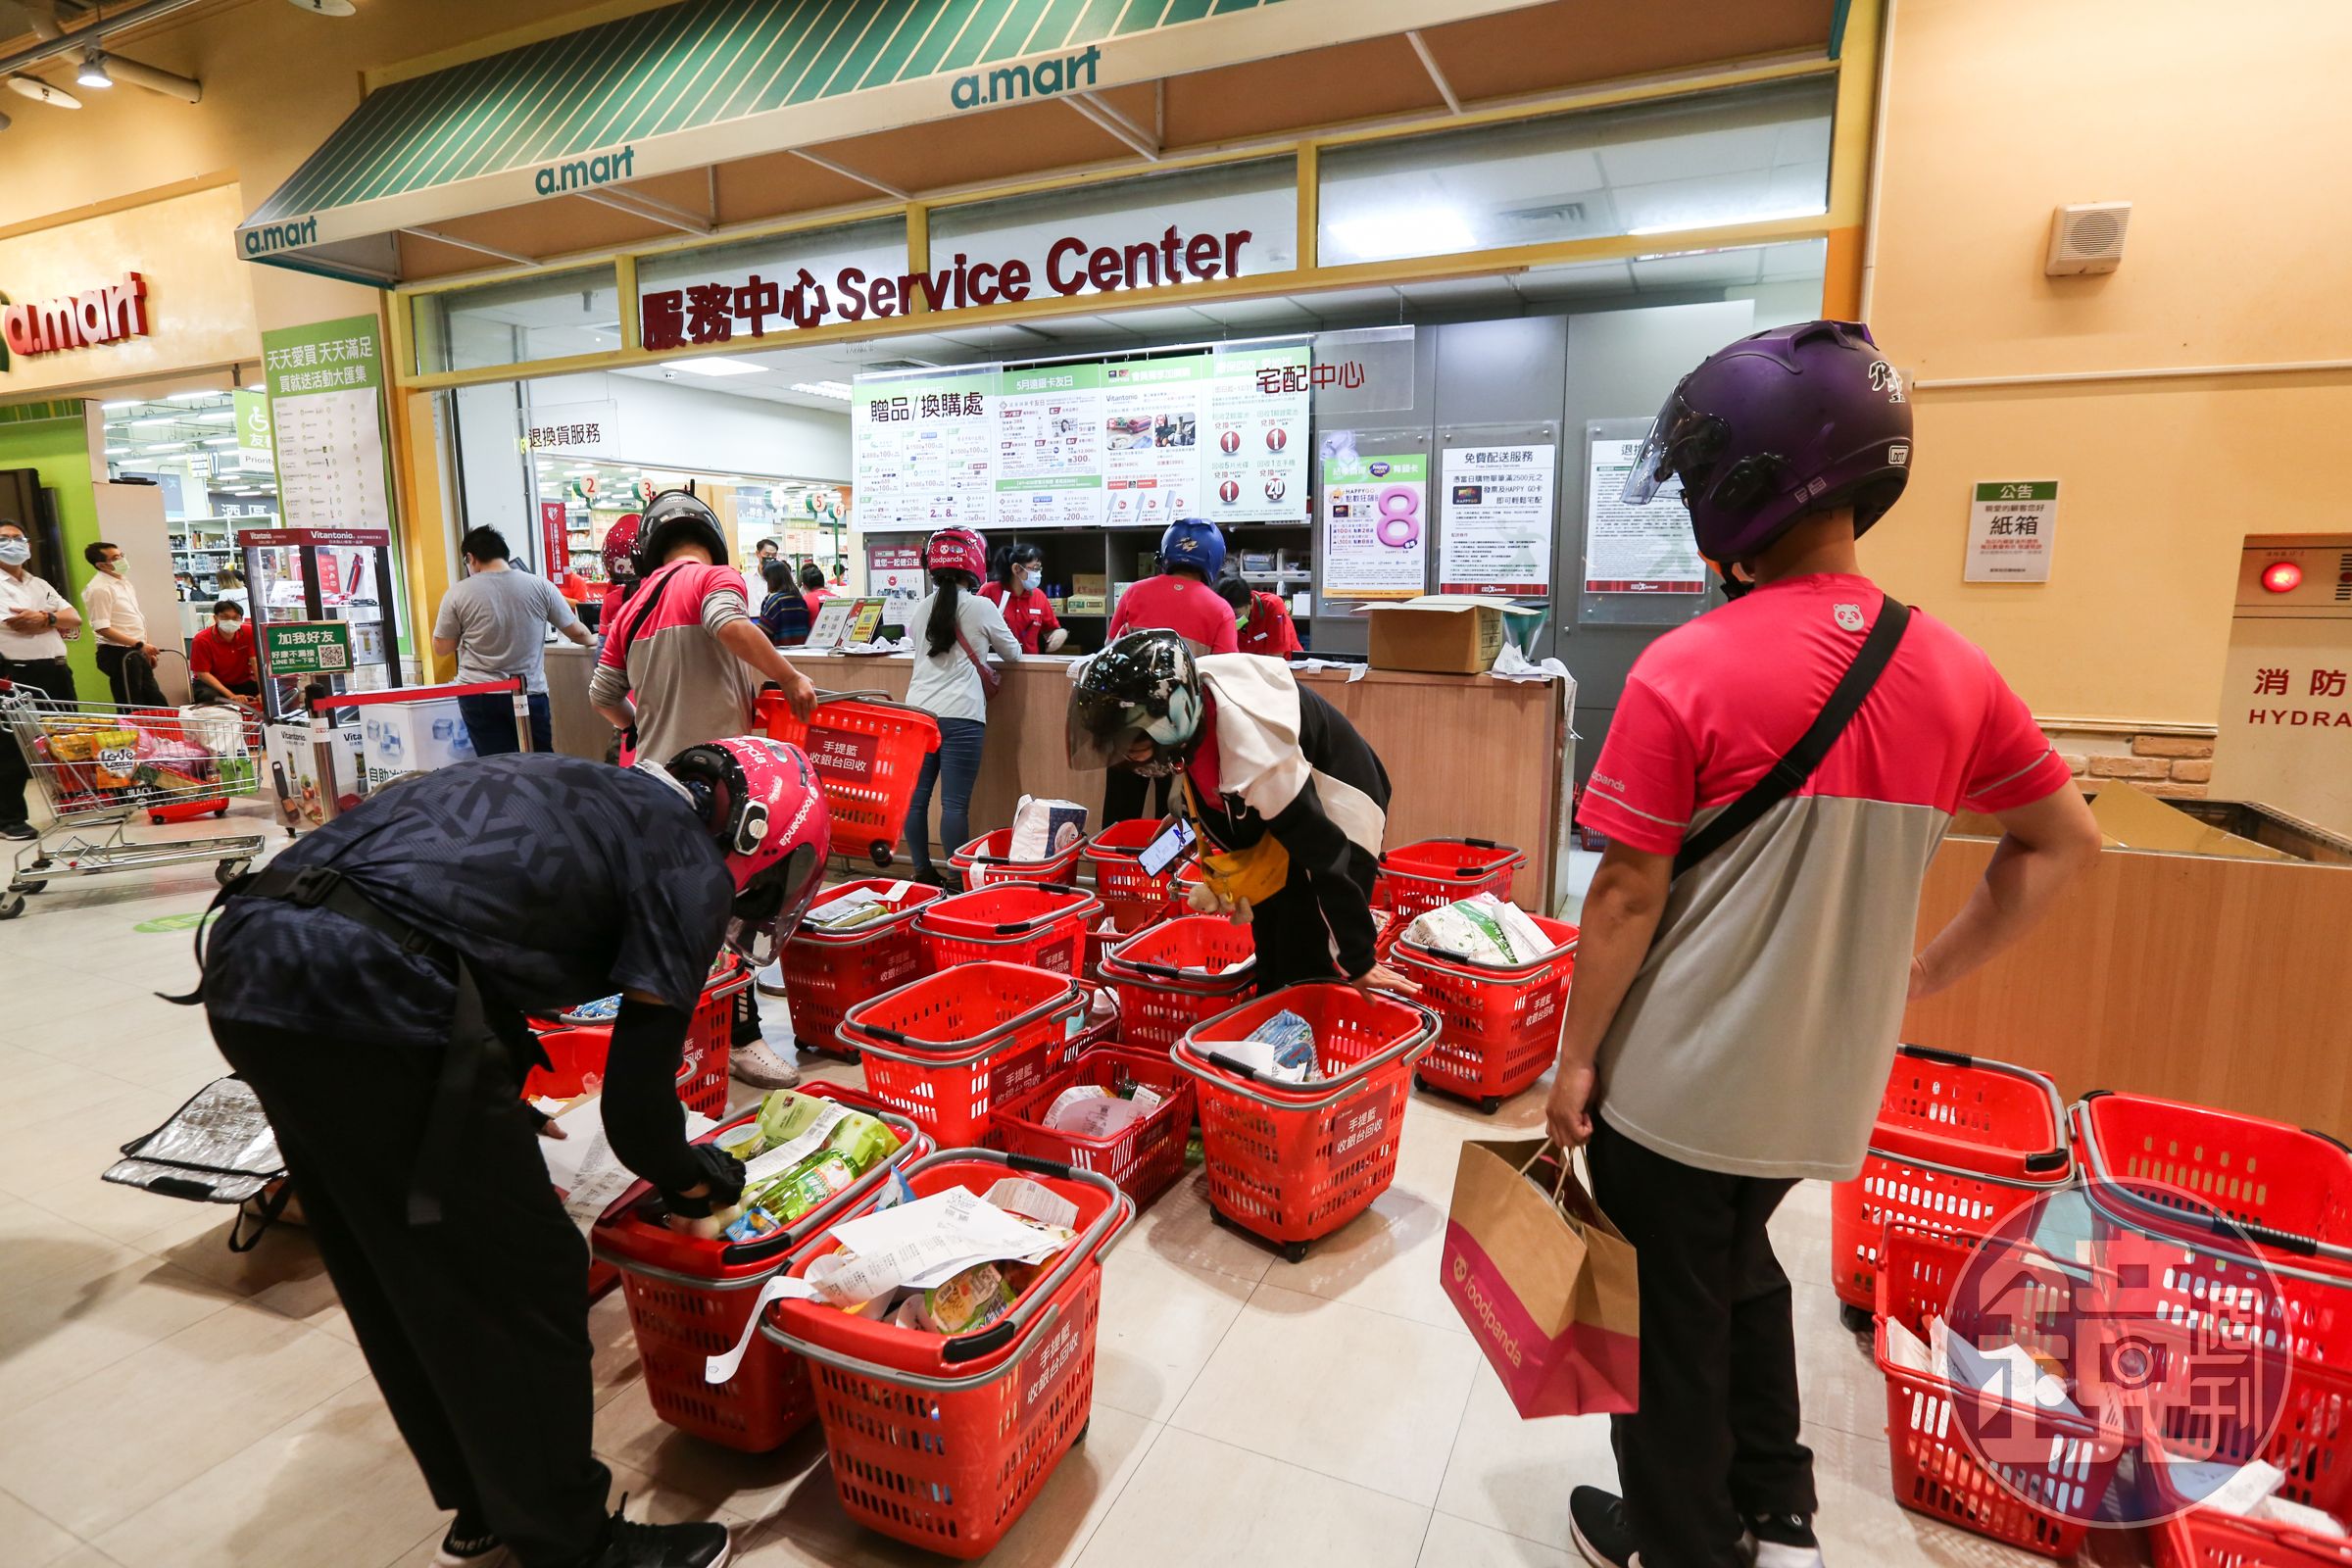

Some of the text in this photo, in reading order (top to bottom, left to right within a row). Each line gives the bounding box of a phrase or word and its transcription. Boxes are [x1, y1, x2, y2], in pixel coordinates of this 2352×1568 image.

[951, 45, 1102, 110] a.mart
[535, 145, 635, 196] a.mart
[245, 215, 318, 255] a.mart
[642, 224, 1253, 352] 服務中心 Service Center
[5, 271, 148, 357] a.mart
[267, 335, 373, 371] 天天愛買 天天滿足
[279, 365, 368, 393] 買就送活動大匯集
[1255, 361, 1365, 394] 宅配中心
[870, 391, 984, 423] 贈品/換購處
[528, 423, 601, 449] 退換貨服務
[1464, 451, 1534, 464] 免費配送服務
[586, 477, 596, 494] 2
[644, 481, 653, 497] 3
[2000, 484, 2034, 500] 公告
[816, 495, 822, 509] 5
[836, 505, 842, 516] 6
[310, 530, 354, 540] Vitantonio
[1988, 515, 2039, 536] 紙箱
[277, 630, 335, 646] 加我好友
[2253, 667, 2347, 698] 消防
[2248, 709, 2352, 728] HYDRA
[808, 752, 867, 773] 收銀台回收
[823, 740, 858, 758] 手提籃
[779, 796, 815, 847] foodpanda
[1348, 1106, 1377, 1133] 手提籃
[1337, 1118, 1384, 1154] 收銀台回收
[1464, 1275, 1523, 1369] foodpanda
[1040, 1319, 1071, 1369] 手提籃
[1027, 1331, 1079, 1405] 收銀台回收
